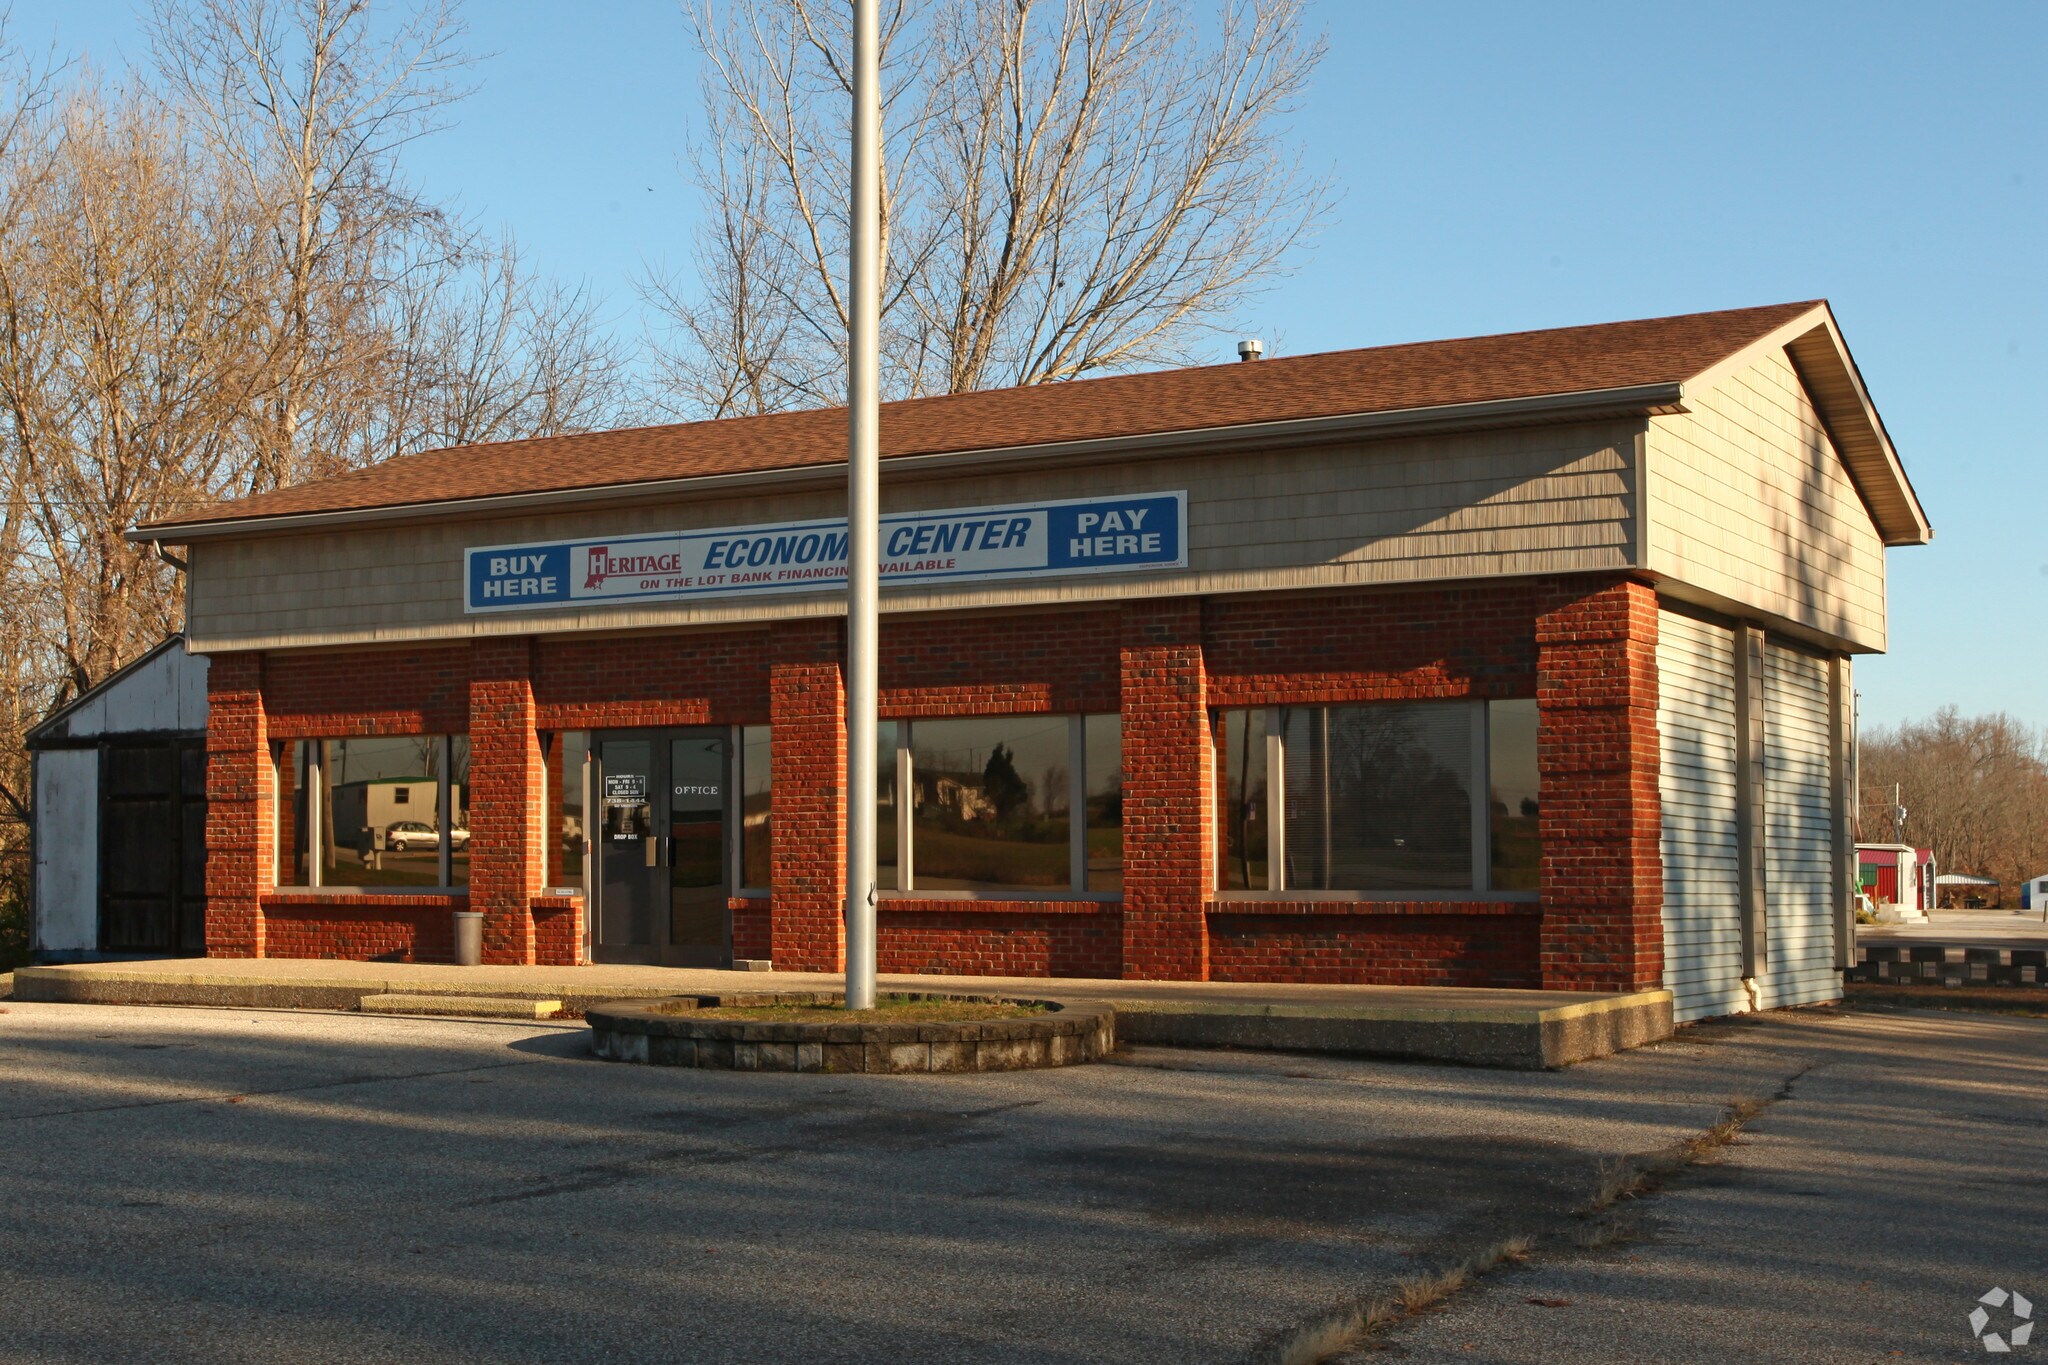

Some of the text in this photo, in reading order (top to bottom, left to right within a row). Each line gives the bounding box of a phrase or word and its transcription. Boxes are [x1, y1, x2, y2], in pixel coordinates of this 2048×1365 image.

[1078, 508, 1149, 534] PAY
[703, 517, 1032, 570] ECONOM CENTER
[1070, 533, 1161, 558] HERE
[490, 554, 548, 576] BUY
[590, 553, 682, 577] HERITAGE
[640, 558, 956, 590] ON THE LOT BANK FINANCIN VAILABLE
[483, 577, 557, 598] HERE
[675, 786, 718, 795] OFFICE
